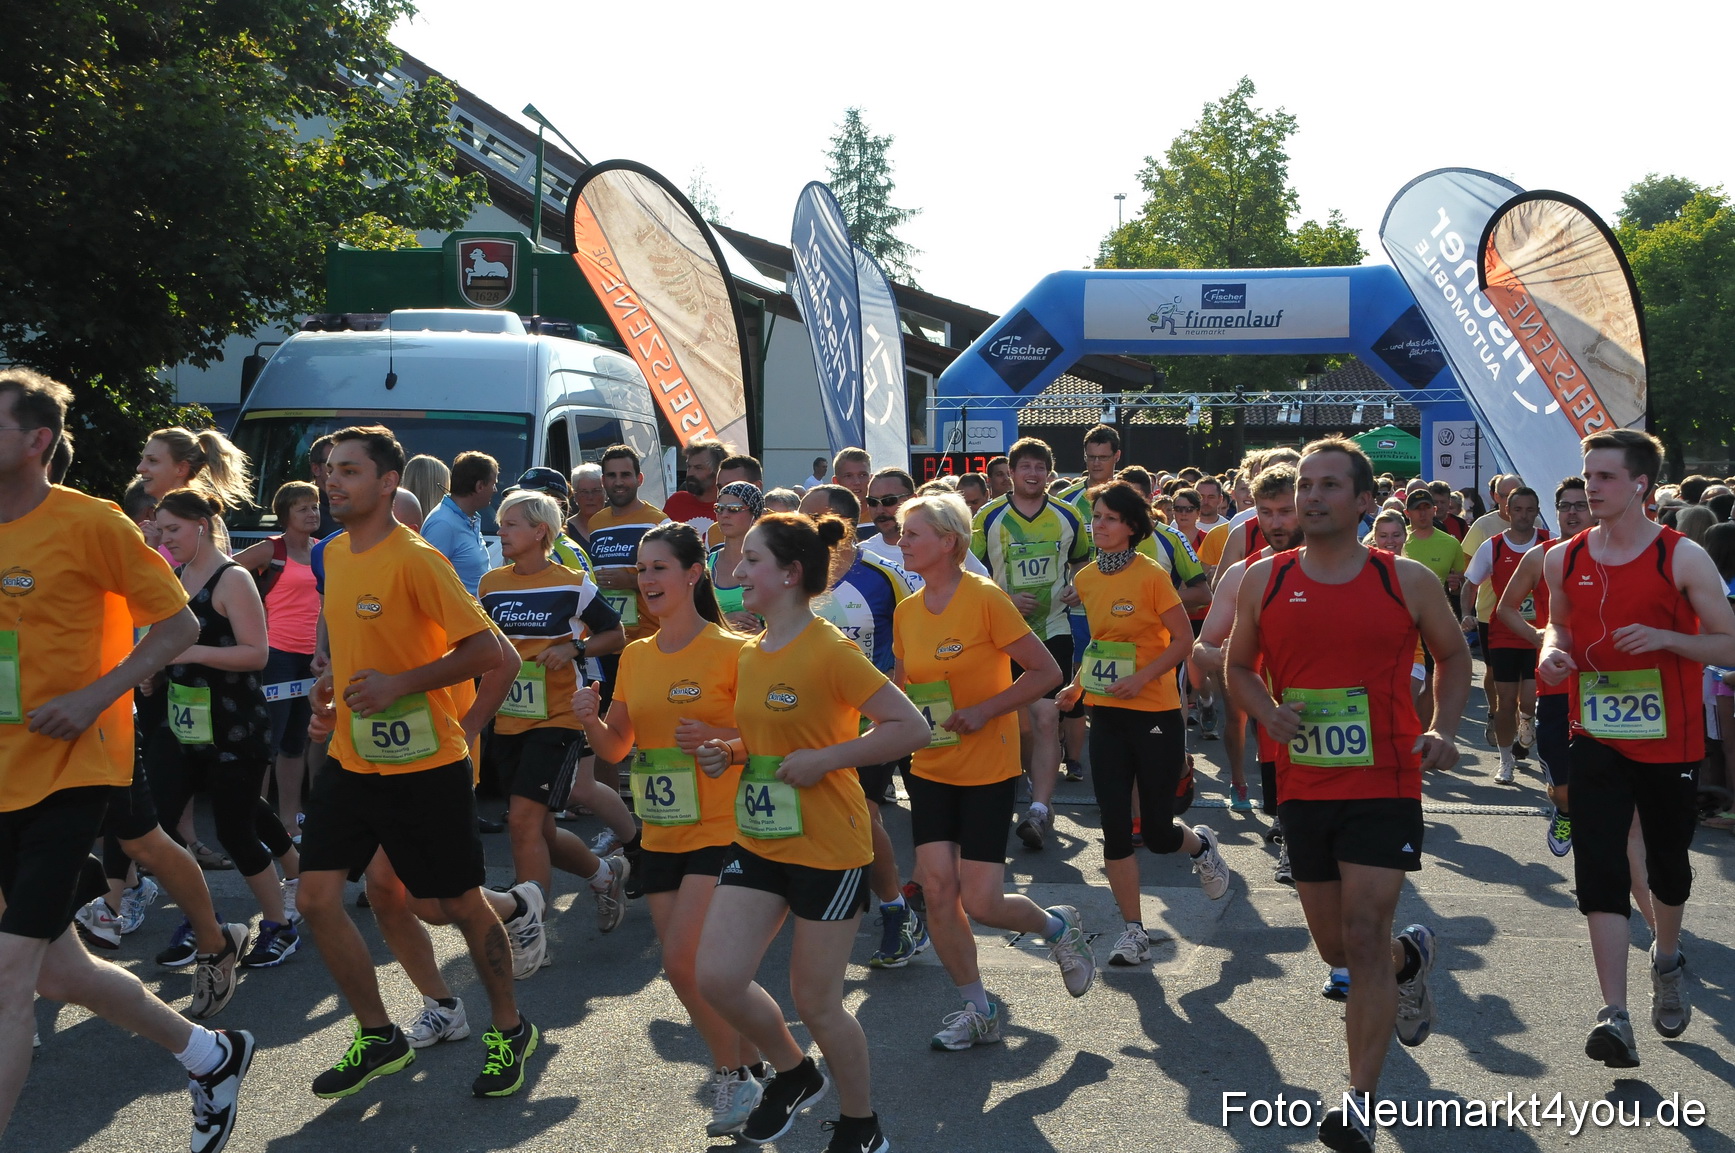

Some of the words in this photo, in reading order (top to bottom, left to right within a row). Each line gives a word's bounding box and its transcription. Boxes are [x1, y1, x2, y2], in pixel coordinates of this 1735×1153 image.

[474, 291, 500, 301] 1628
[1185, 309, 1284, 328] firmenlauf
[1185, 328, 1226, 336] neumarkt
[1000, 344, 1051, 355] Fischer
[596, 543, 635, 554] Fischer
[1018, 557, 1050, 577] 107
[500, 610, 552, 621] Fischer
[1091, 660, 1118, 683] 44
[507, 680, 534, 704] 01
[172, 703, 195, 729] 24
[1583, 693, 1661, 723] 1326
[372, 720, 411, 748] 50
[1291, 724, 1367, 756] 5109
[645, 775, 676, 807] 43
[744, 783, 776, 818] 64
